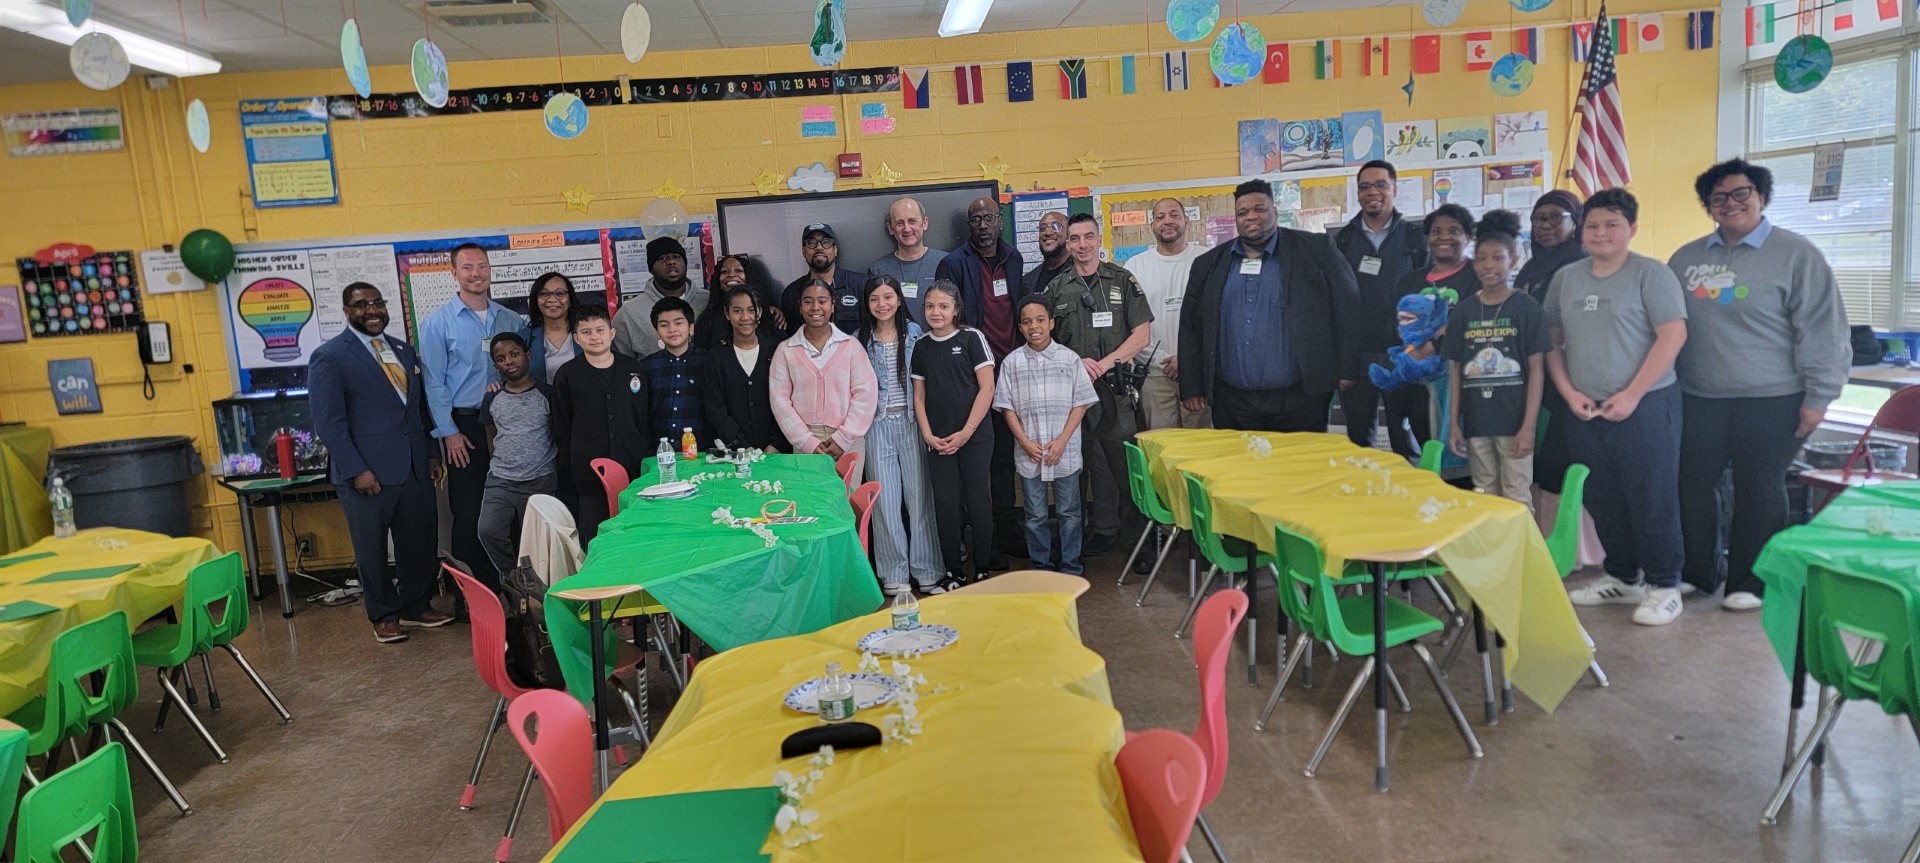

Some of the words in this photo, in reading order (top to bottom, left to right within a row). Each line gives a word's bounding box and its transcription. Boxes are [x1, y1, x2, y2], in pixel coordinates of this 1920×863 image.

[614, 87, 621, 98] 0
[633, 86, 638, 96] 1
[646, 86, 652, 96] 2
[659, 85, 665, 95] 3
[672, 84, 679, 95] 4
[686, 84, 693, 95] 5
[701, 83, 708, 94] 6
[714, 83, 720, 93] 7
[728, 82, 735, 92] 8
[741, 81, 747, 92] 9
[752, 81, 762, 92] 10
[769, 80, 777, 91] 11
[781, 80, 790, 90] 12
[794, 79, 804, 89] 13
[807, 78, 817, 89] 14
[820, 77, 830, 88] 15
[835, 76, 845, 87] 16
[848, 76, 857, 86] 17
[861, 75, 871, 86] 18
[874, 74, 884, 84] 19
[886, 73, 898, 84] 20
[1113, 215, 1125, 223] ELA
[512, 236, 540, 246] Learning
[238, 256, 267, 264] HIGHER
[271, 254, 298, 262] ORDER
[409, 254, 452, 264] Multiplic
[233, 265, 273, 274] THINKING
[276, 263, 305, 271] SKILLS
[1464, 328, 1493, 339] WORLD
[1494, 327, 1518, 337] EXPO
[57, 375, 89, 393] can
